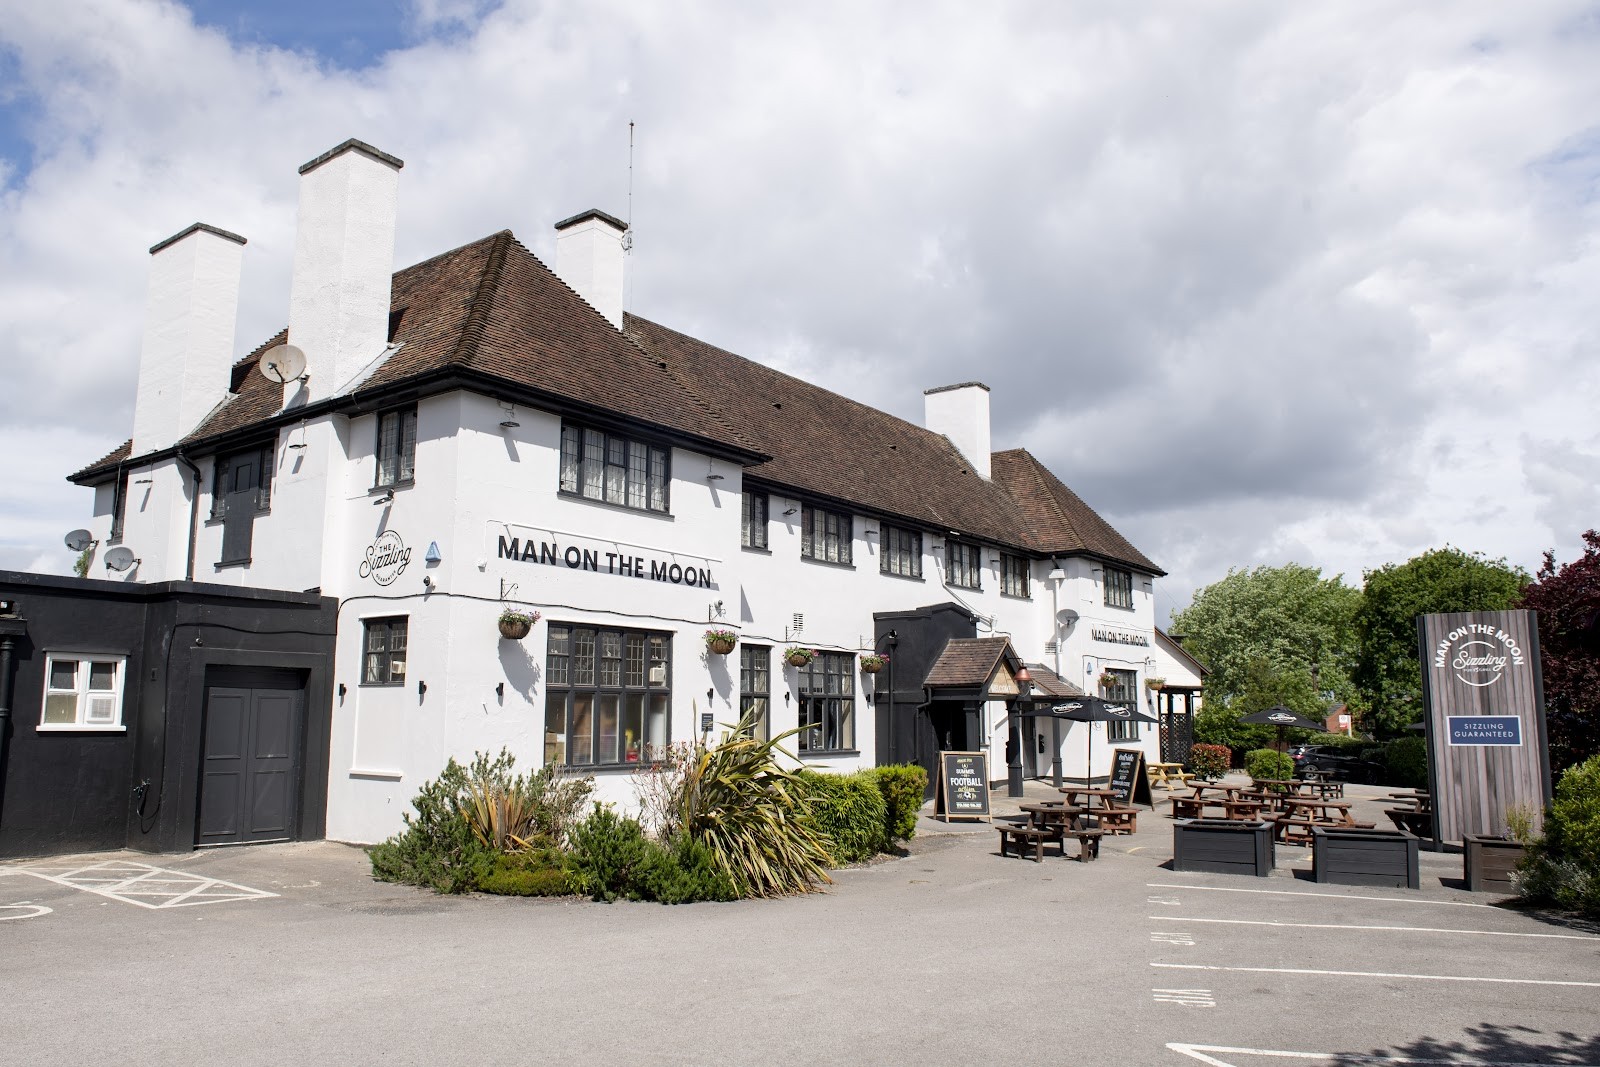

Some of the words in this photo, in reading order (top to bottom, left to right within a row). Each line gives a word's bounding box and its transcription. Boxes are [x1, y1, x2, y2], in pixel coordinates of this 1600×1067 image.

[380, 544, 392, 553] THE
[359, 544, 412, 579] Sizzling
[498, 535, 557, 566] MAN
[564, 546, 598, 572] ON
[605, 552, 644, 578] THE
[650, 559, 711, 589] MOON
[1091, 628, 1107, 642] MAN
[1107, 631, 1117, 644] ON
[1118, 633, 1129, 645] THE
[1129, 635, 1148, 648] MOON
[1434, 639, 1452, 668] MAN
[1448, 626, 1469, 641] ON
[1468, 623, 1496, 636] THE
[1495, 629, 1524, 665] MOON
[1452, 650, 1507, 672] Sizzling
[950, 777, 983, 787] FOOTBALL
